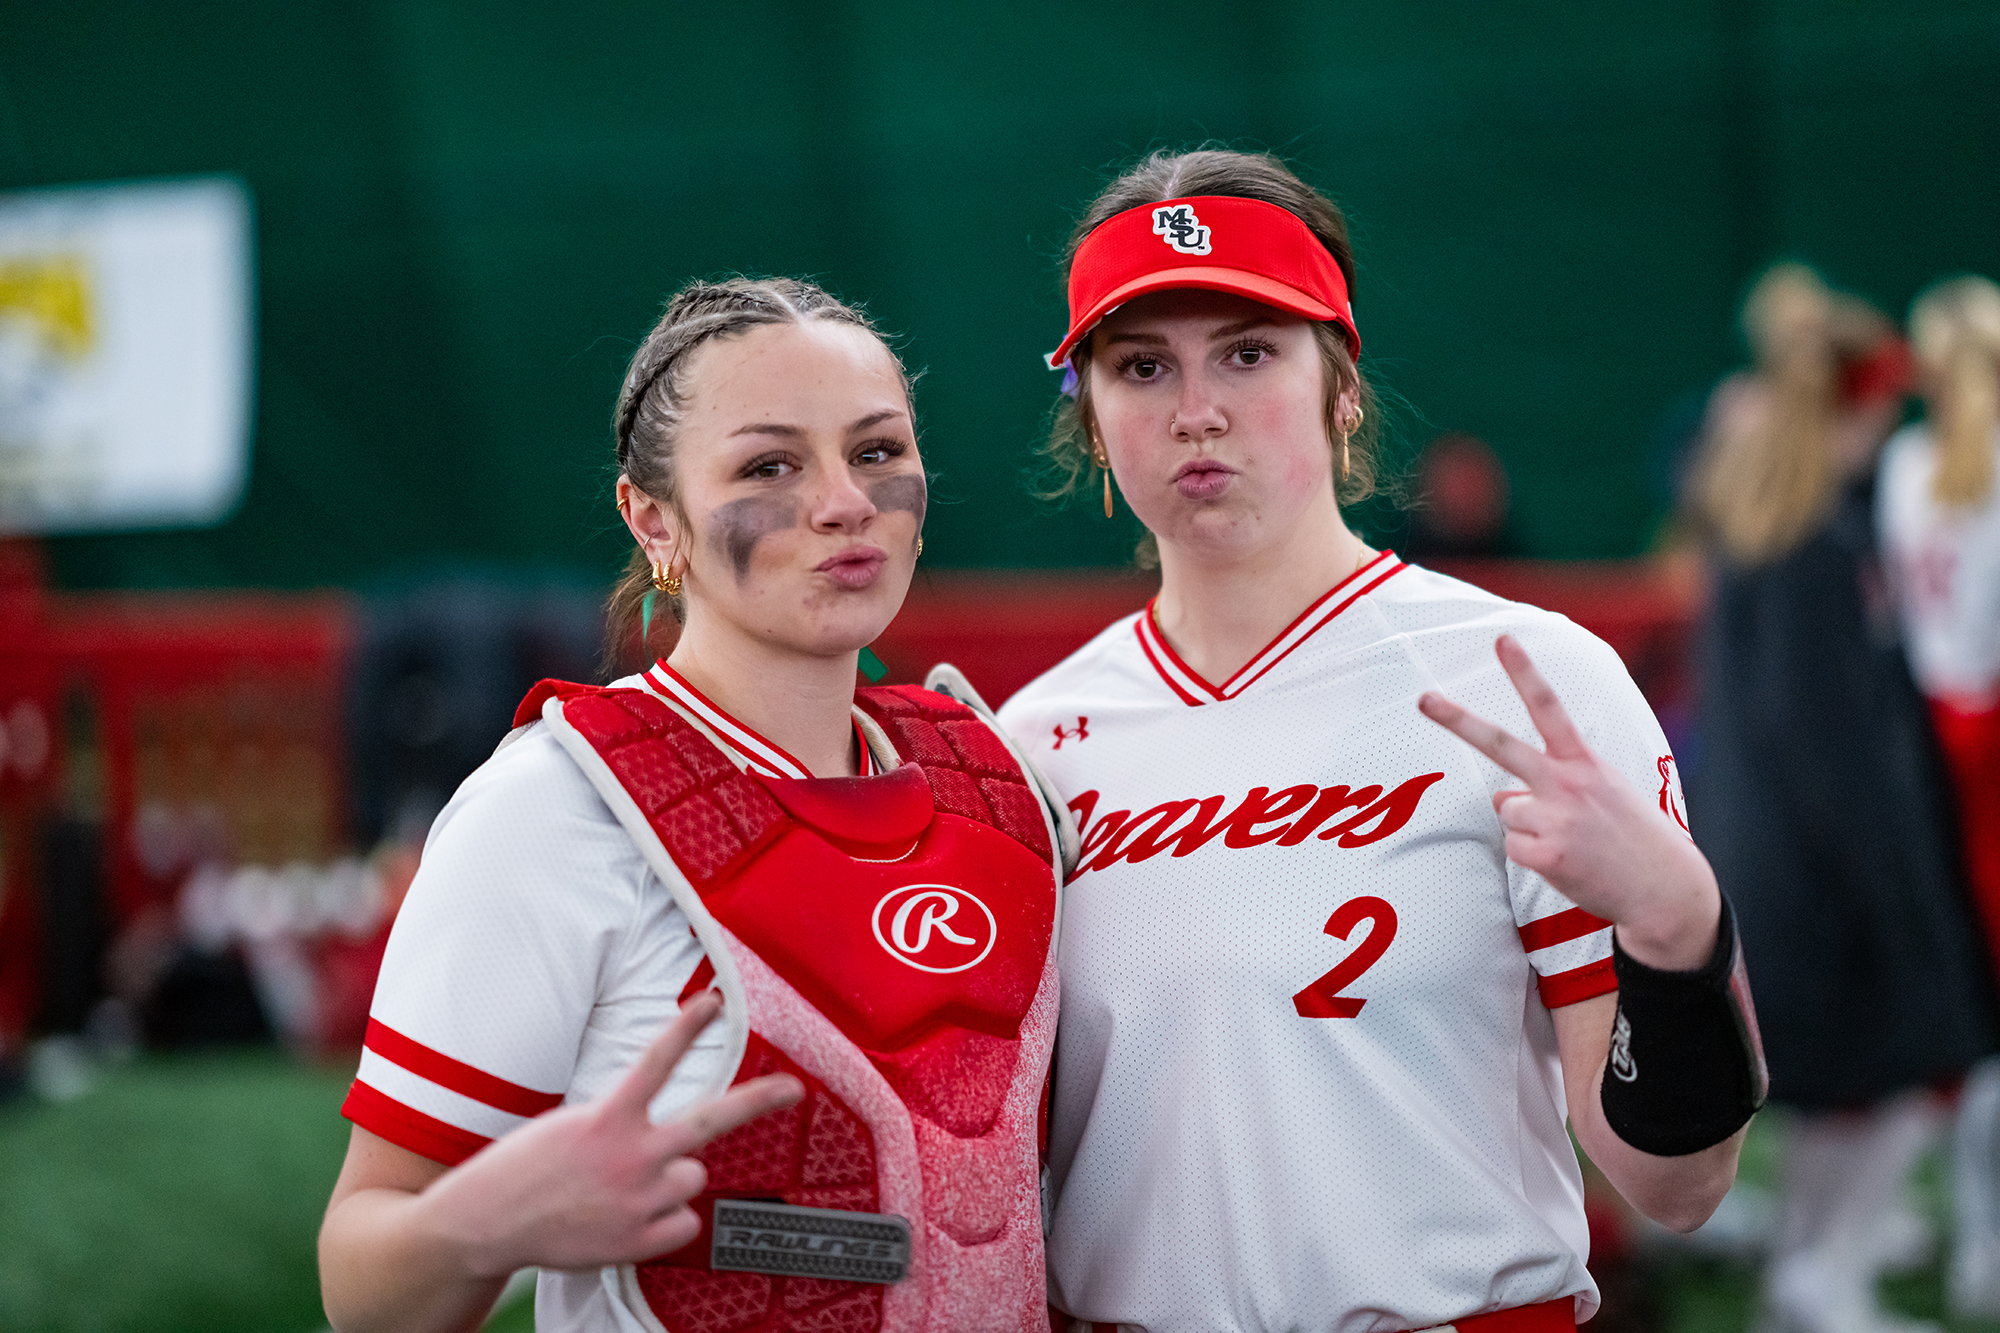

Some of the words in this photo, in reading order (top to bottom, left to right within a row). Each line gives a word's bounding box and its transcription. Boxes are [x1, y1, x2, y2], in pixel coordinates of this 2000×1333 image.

[1158, 208, 1205, 248] MSU
[891, 891, 977, 954] R
[1292, 895, 1398, 1018] 2
[727, 1229, 894, 1259] RAWLINGS
